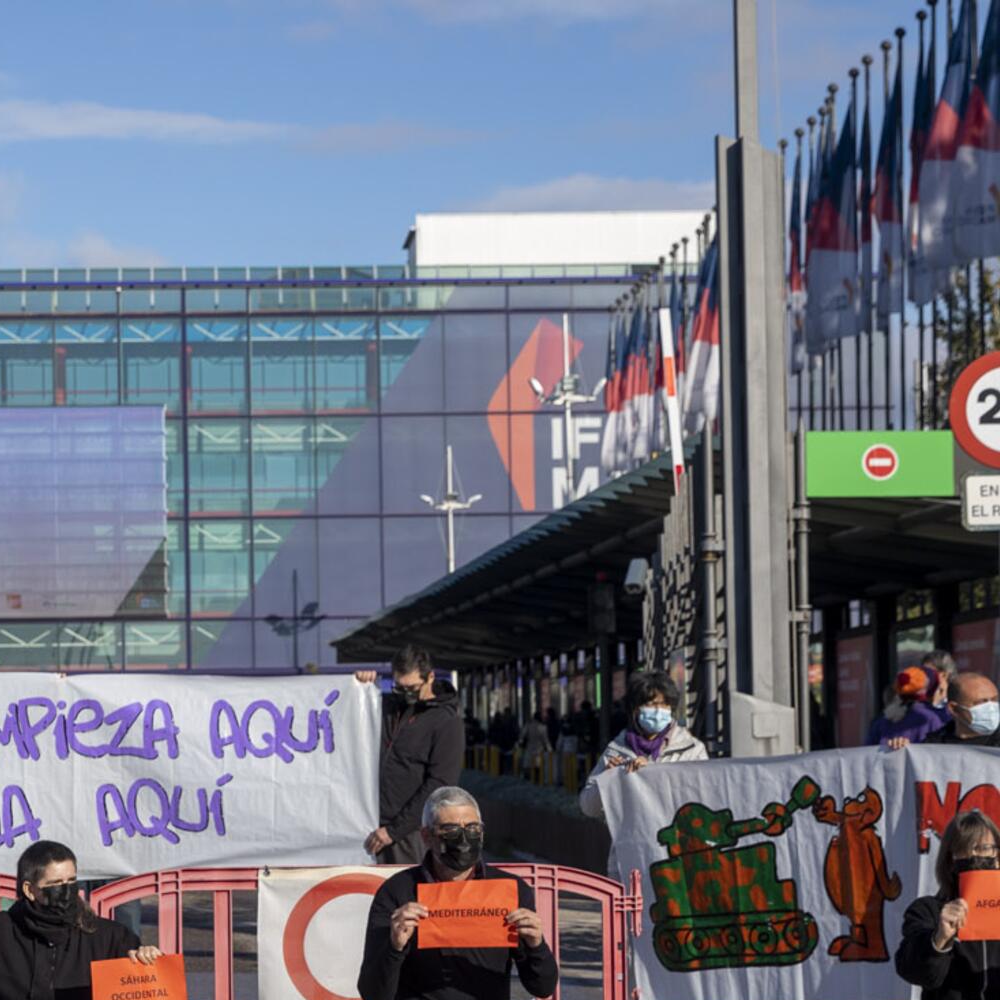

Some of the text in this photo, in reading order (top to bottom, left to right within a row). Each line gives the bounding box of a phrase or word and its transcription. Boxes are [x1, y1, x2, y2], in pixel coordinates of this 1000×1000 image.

[971, 505, 988, 517] EL
[209, 689, 340, 764] AQUÍ
[95, 773, 233, 847] AQUÍ
[428, 906, 509, 919] MEDITERRÁNEO
[119, 973, 157, 986] SÁHARA
